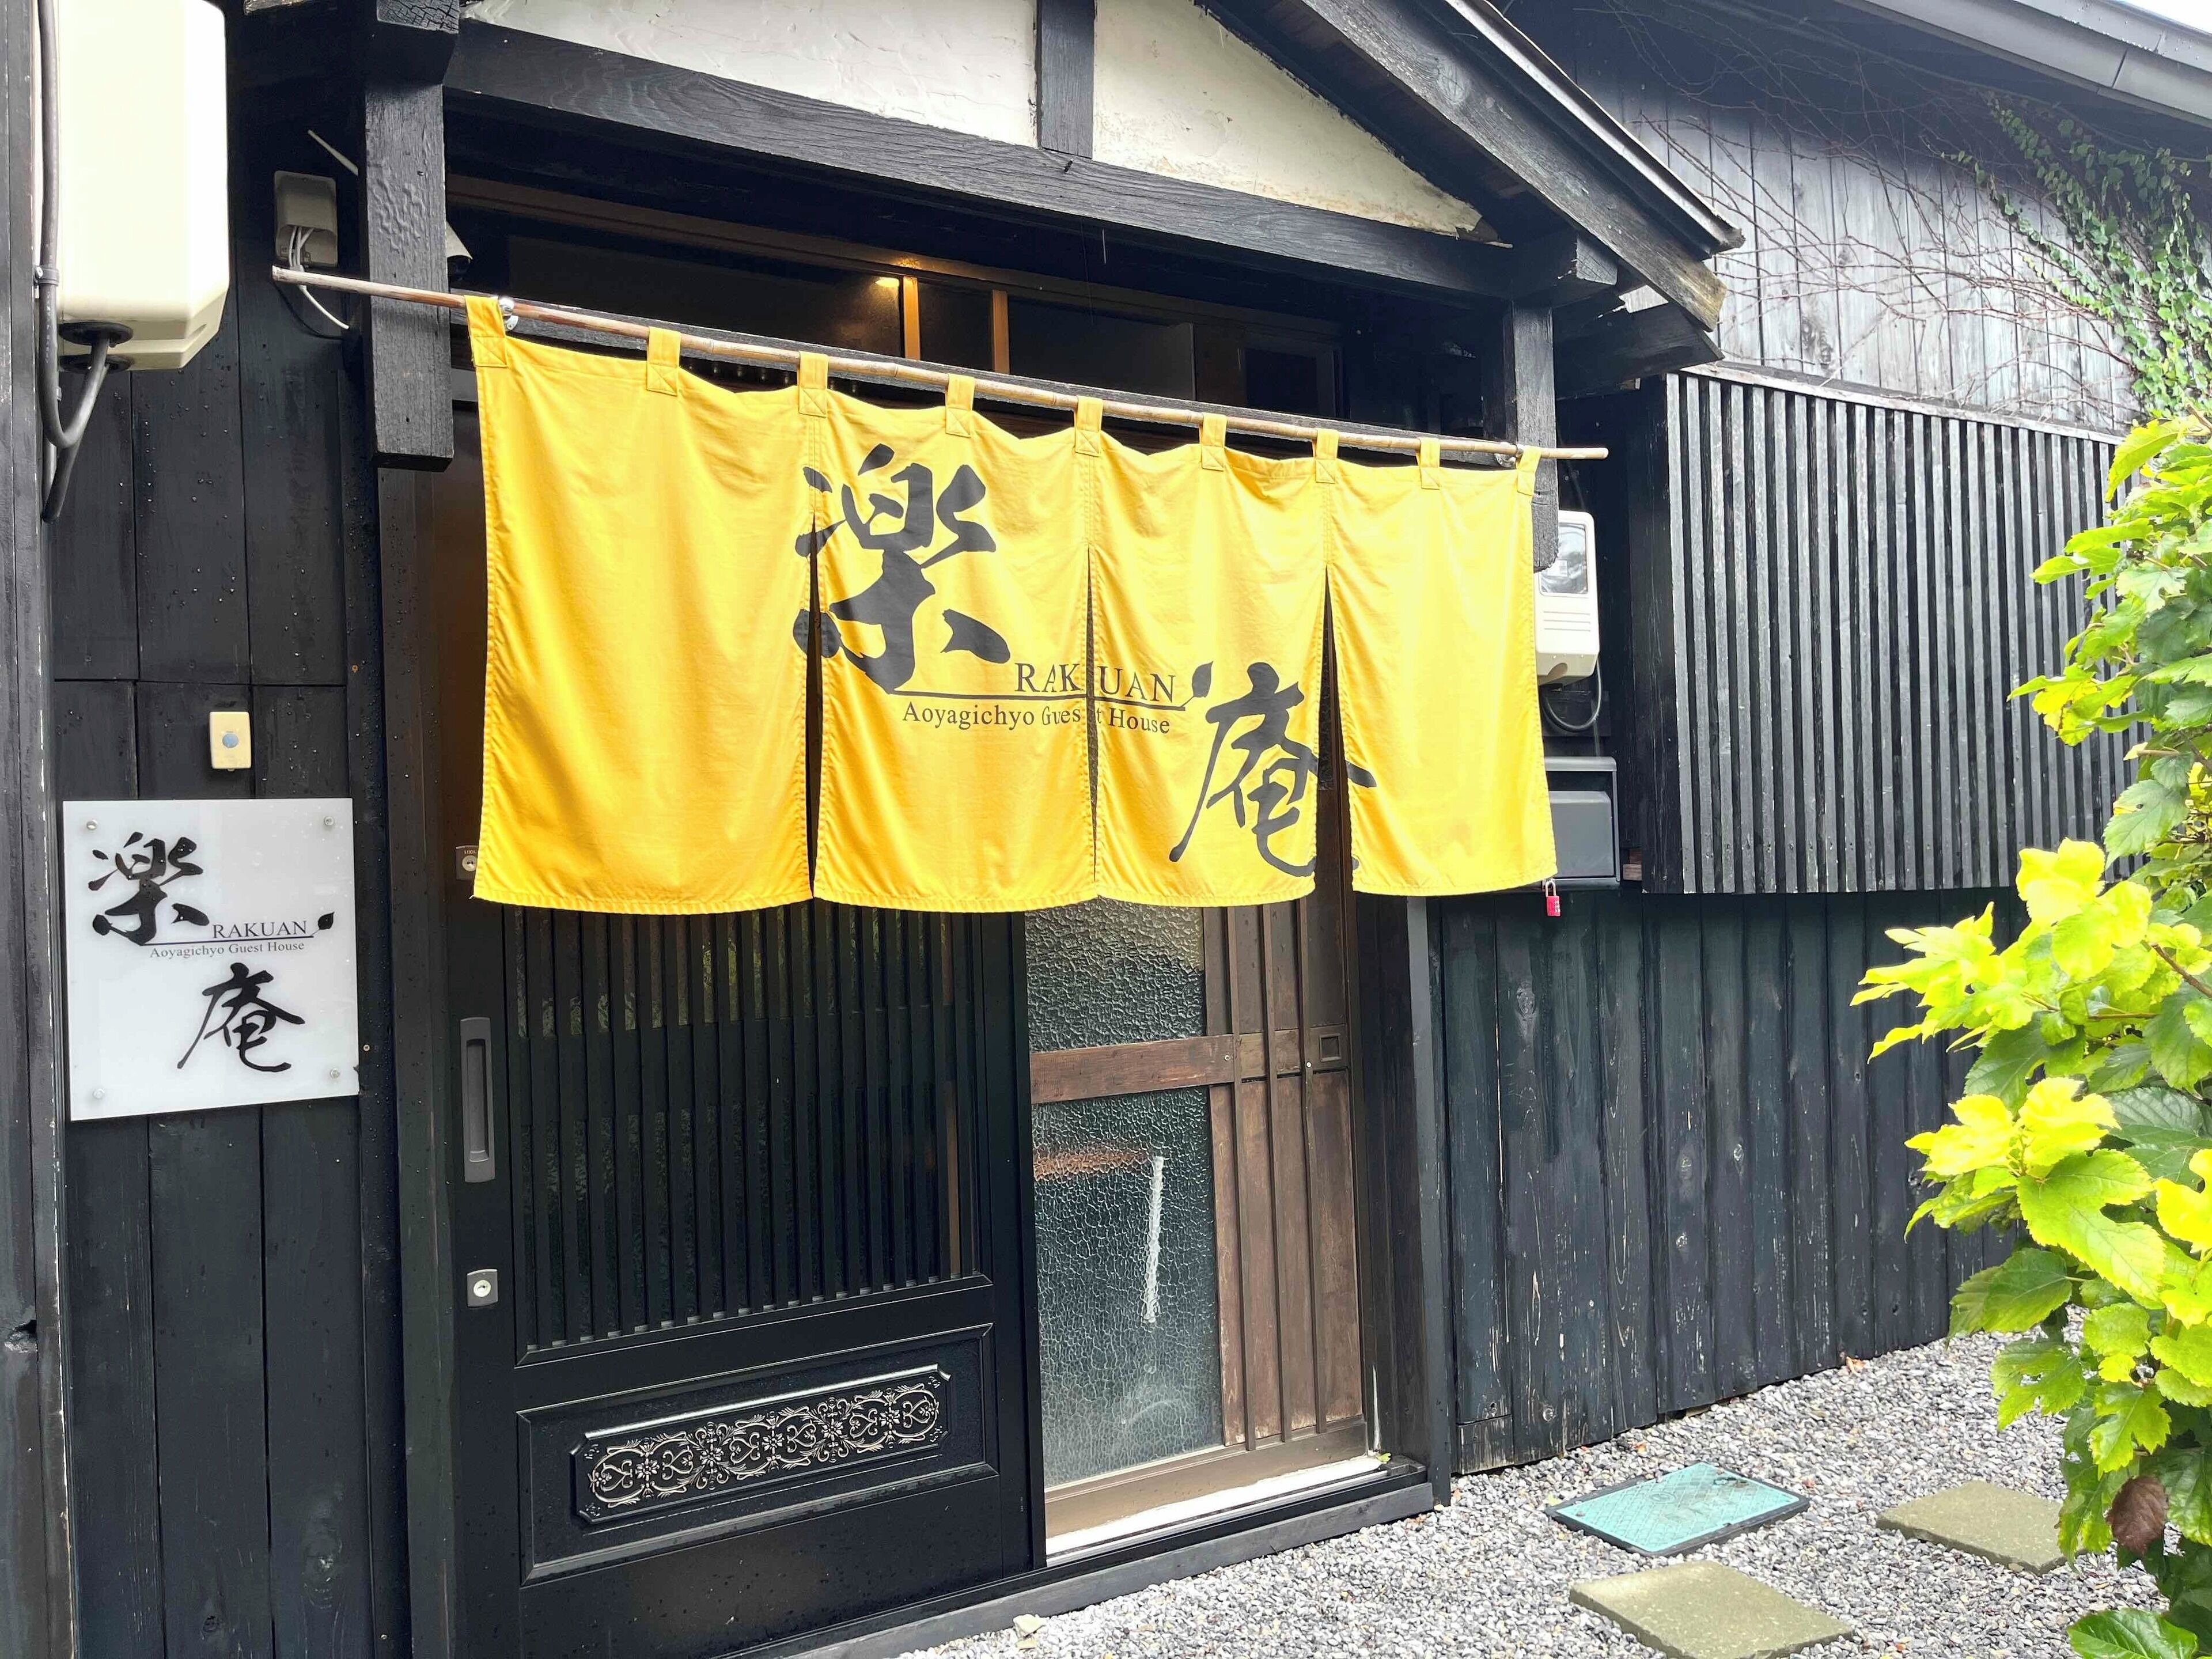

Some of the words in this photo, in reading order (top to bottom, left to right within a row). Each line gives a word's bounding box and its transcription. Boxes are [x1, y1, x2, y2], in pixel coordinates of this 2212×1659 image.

[1014, 662, 1176, 703] RAKUAN
[902, 700, 1035, 730] Aoyagichyo
[1041, 705, 1103, 726] Guest
[1108, 707, 1171, 734] House
[213, 921, 308, 938] RAKUAN
[150, 945, 225, 960] Aoyagichyo
[229, 942, 263, 954] Guest
[268, 941, 305, 952] House
